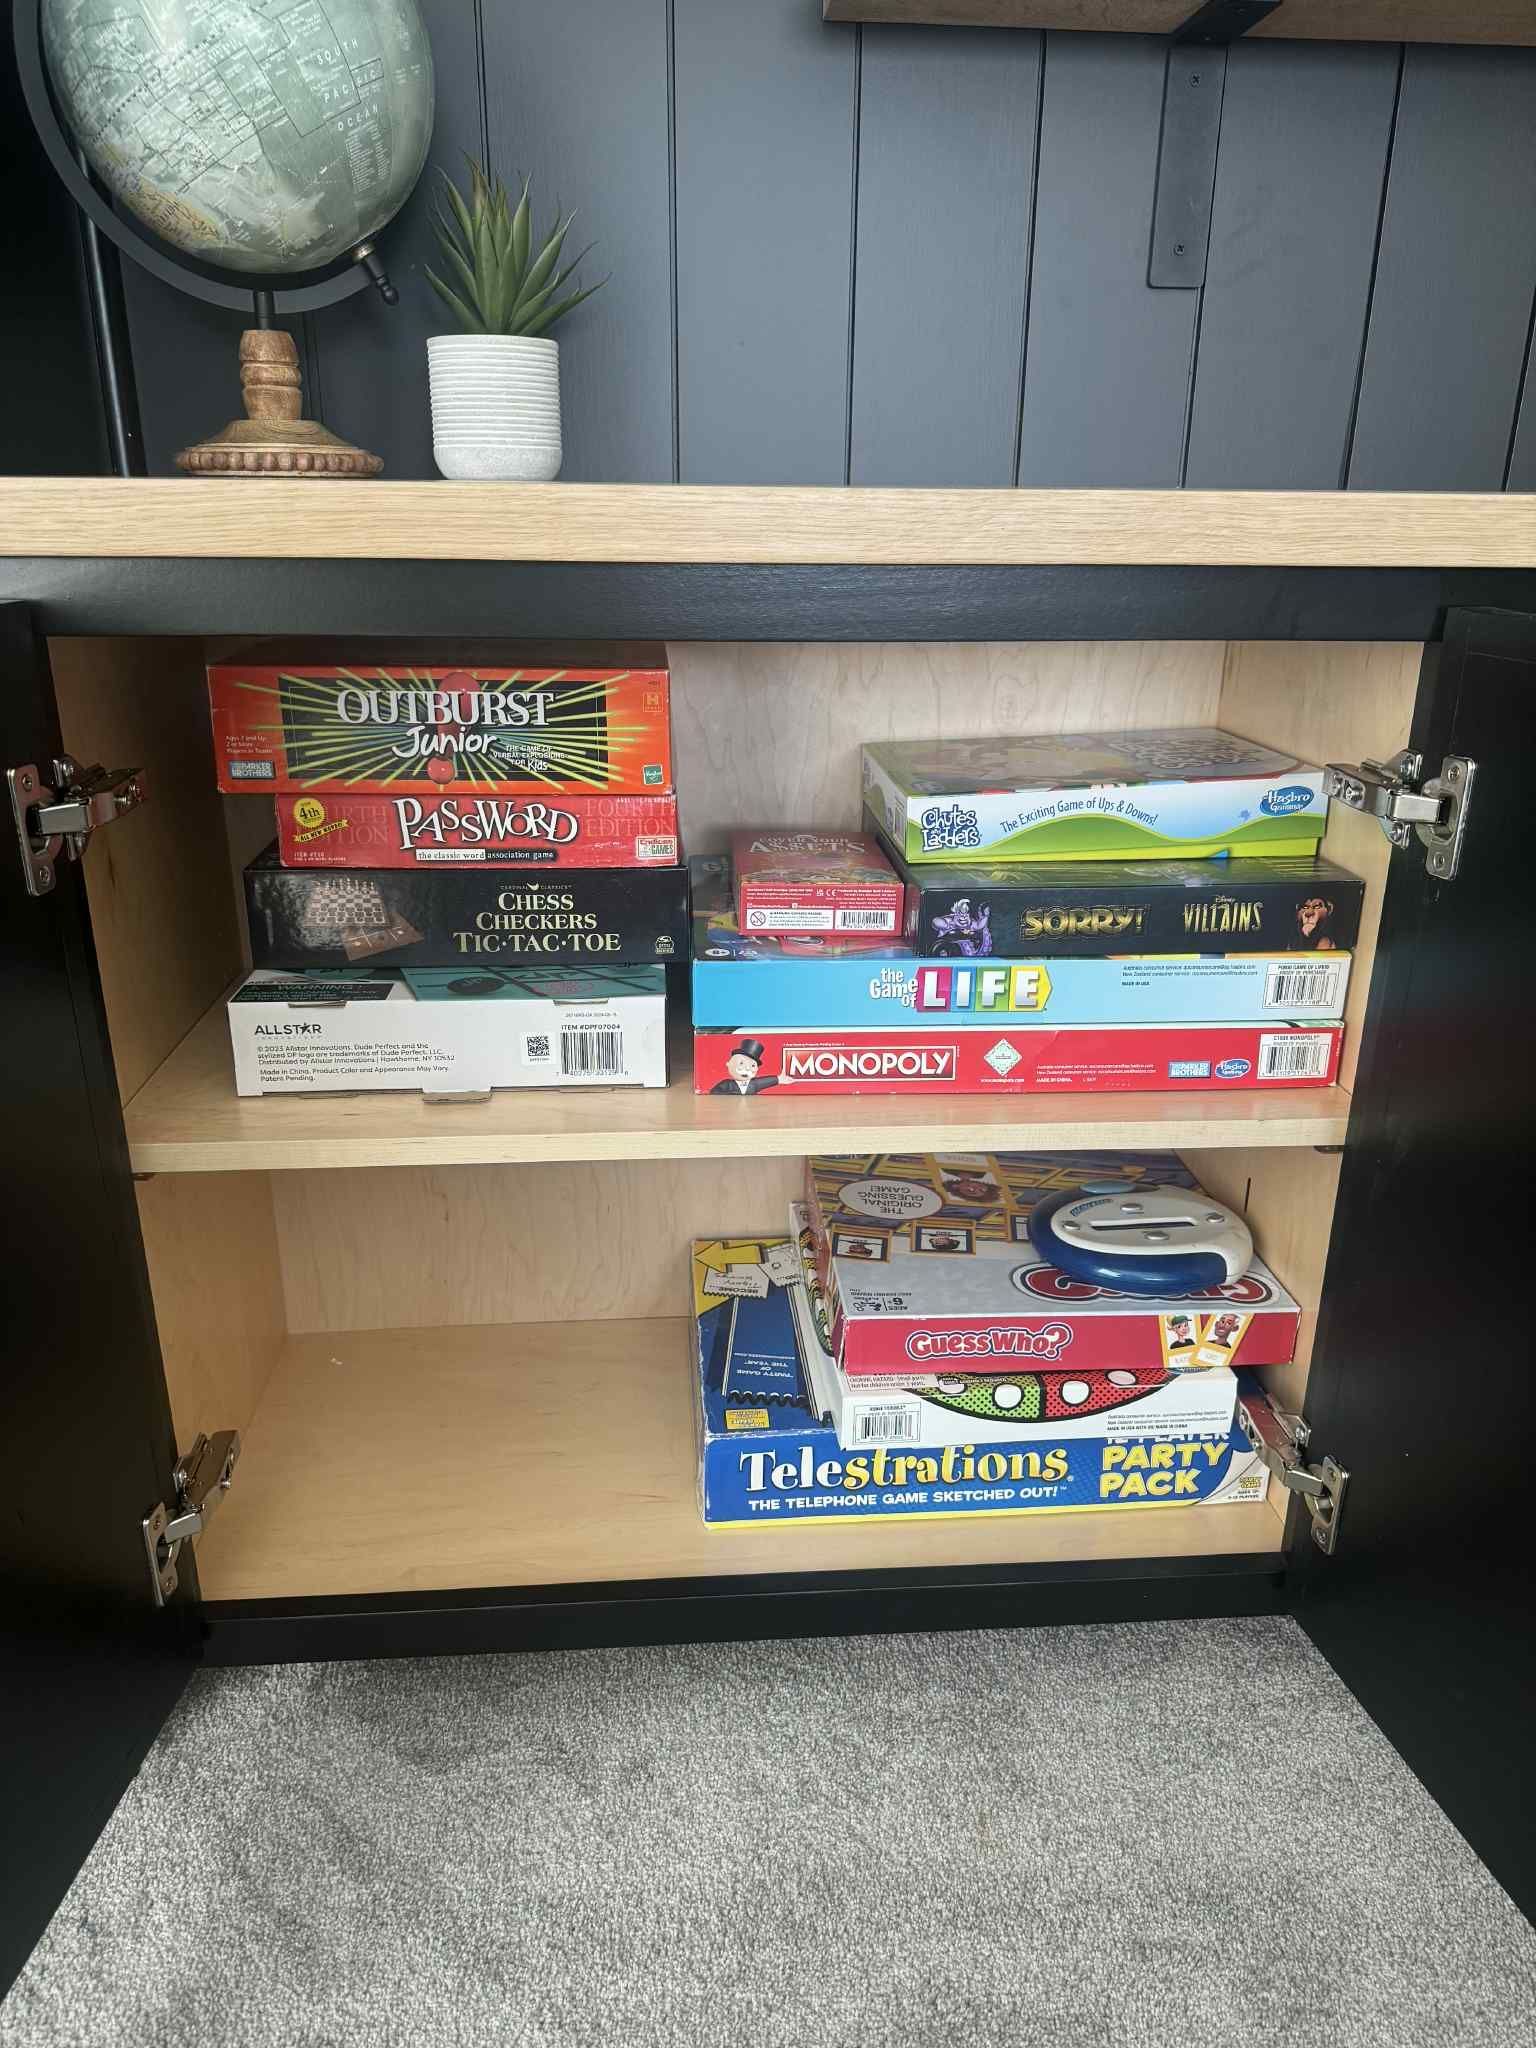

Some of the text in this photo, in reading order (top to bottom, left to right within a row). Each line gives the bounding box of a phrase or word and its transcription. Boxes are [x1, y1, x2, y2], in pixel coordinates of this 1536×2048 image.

[317, 39, 359, 65] SOUTH
[338, 104, 378, 131] OCEAN
[336, 689, 554, 726] OUTBURST
[392, 726, 497, 758] Junior
[1267, 790, 1311, 804] Hasbro
[300, 807, 320, 819] 4th
[392, 797, 578, 850] PASSWORD
[922, 804, 976, 829] Chutes
[1000, 797, 1159, 833] The Exciting Game of Ups & Downs!
[587, 817, 674, 836] EDITION
[922, 827, 979, 851] Ladders
[418, 851, 554, 861] the classic word association game
[498, 892, 574, 911] CHESS
[476, 912, 598, 930] CHECKERS
[1023, 907, 1145, 937] SORRY!
[1183, 902, 1264, 932] VILLAINS
[881, 967, 904, 982] the
[869, 977, 919, 999] Game
[923, 970, 1040, 1008] LIFE
[902, 993, 918, 1009] of
[789, 1051, 951, 1076] MONOPOLY
[857, 1192, 924, 1201] GUESSING
[862, 1200, 922, 1208] ORIGINAL
[880, 1207, 904, 1215] THE
[739, 1444, 1070, 1491] Telestrations
[1102, 1442, 1230, 1471] PARTY
[1099, 1468, 1202, 1498] PACK
[749, 1485, 1058, 1511] THE TELEPHONE GAME SKETCHED OUT!
